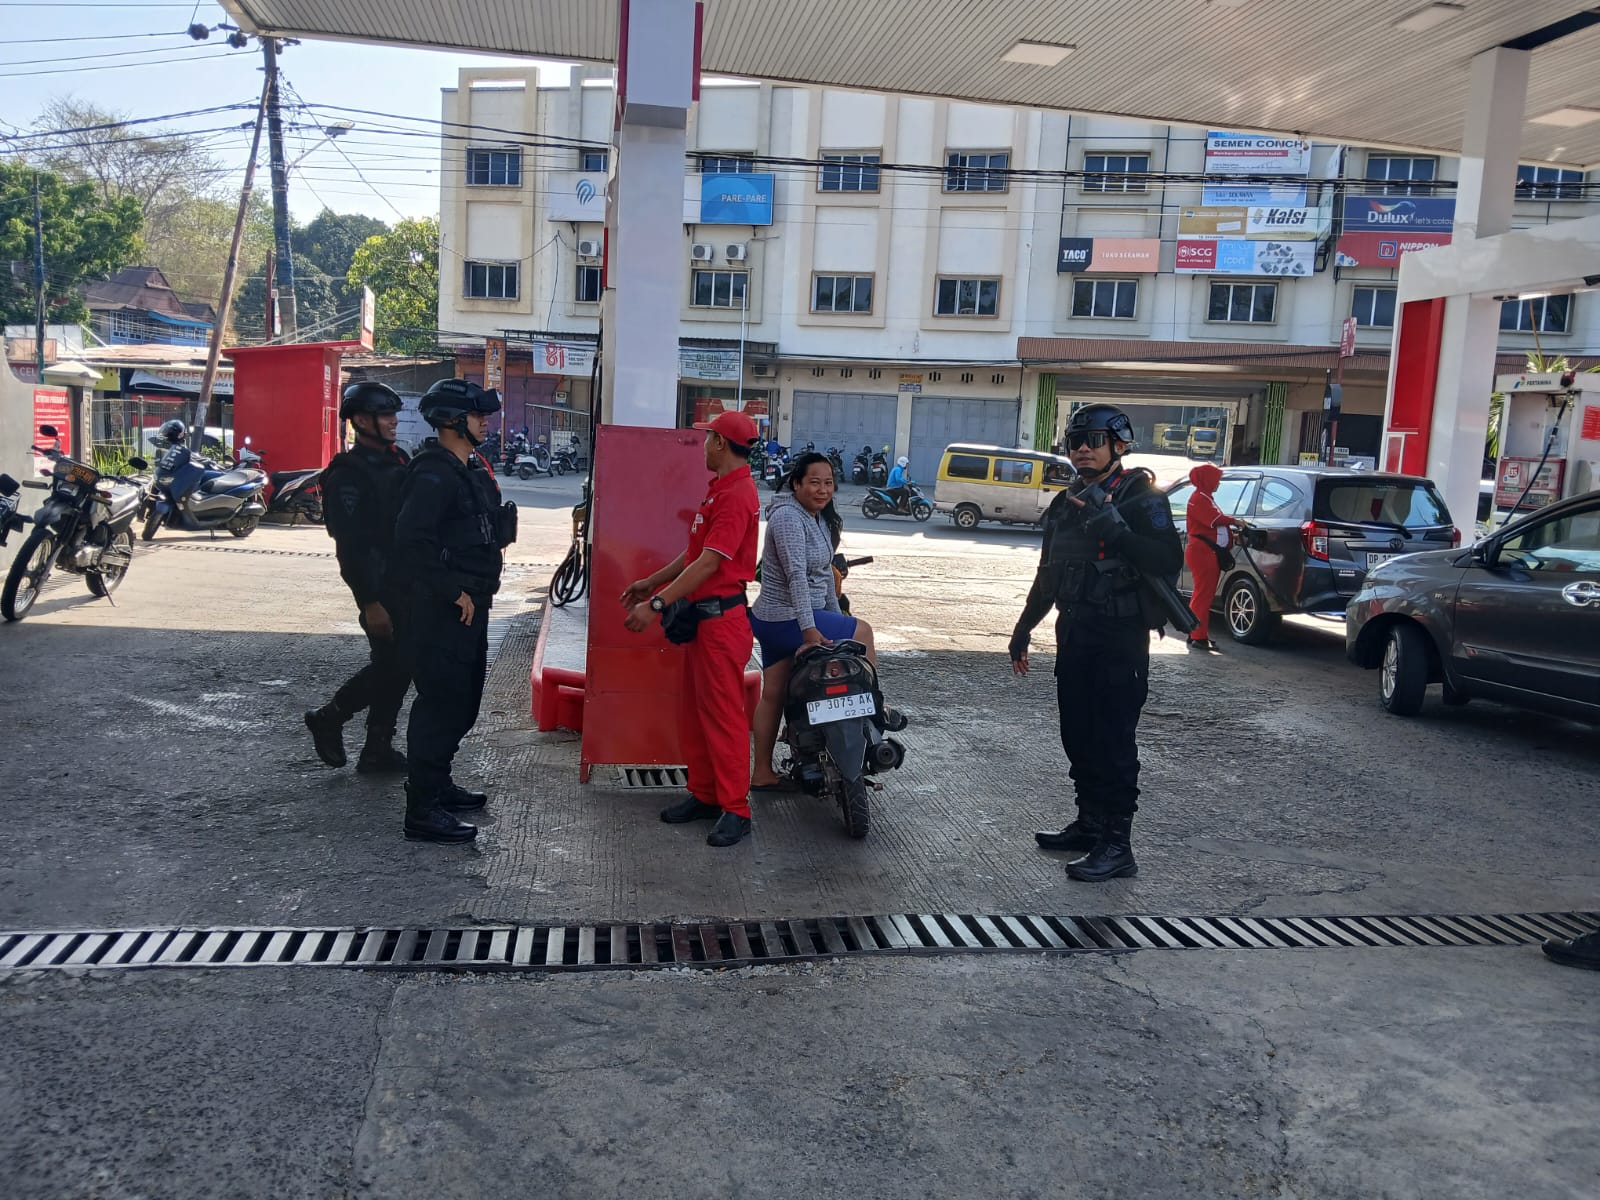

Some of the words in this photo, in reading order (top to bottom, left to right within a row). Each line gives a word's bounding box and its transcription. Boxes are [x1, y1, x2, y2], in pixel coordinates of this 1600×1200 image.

[1256, 140, 1302, 148] CONCH
[721, 194, 767, 203] PARE-PARE
[1266, 208, 1309, 225] Kalsi
[1367, 211, 1409, 224] Dulux
[1416, 217, 1431, 225] let's
[1432, 217, 1454, 225] colou
[1400, 242, 1439, 250] NIPPON
[1063, 250, 1086, 259] TACO
[1190, 248, 1212, 256] SCG
[156, 369, 203, 379] GEPRE
[1369, 554, 1379, 563] DP
[808, 702, 820, 712] DP
[827, 697, 853, 709] 3075
[860, 694, 872, 704] AK
